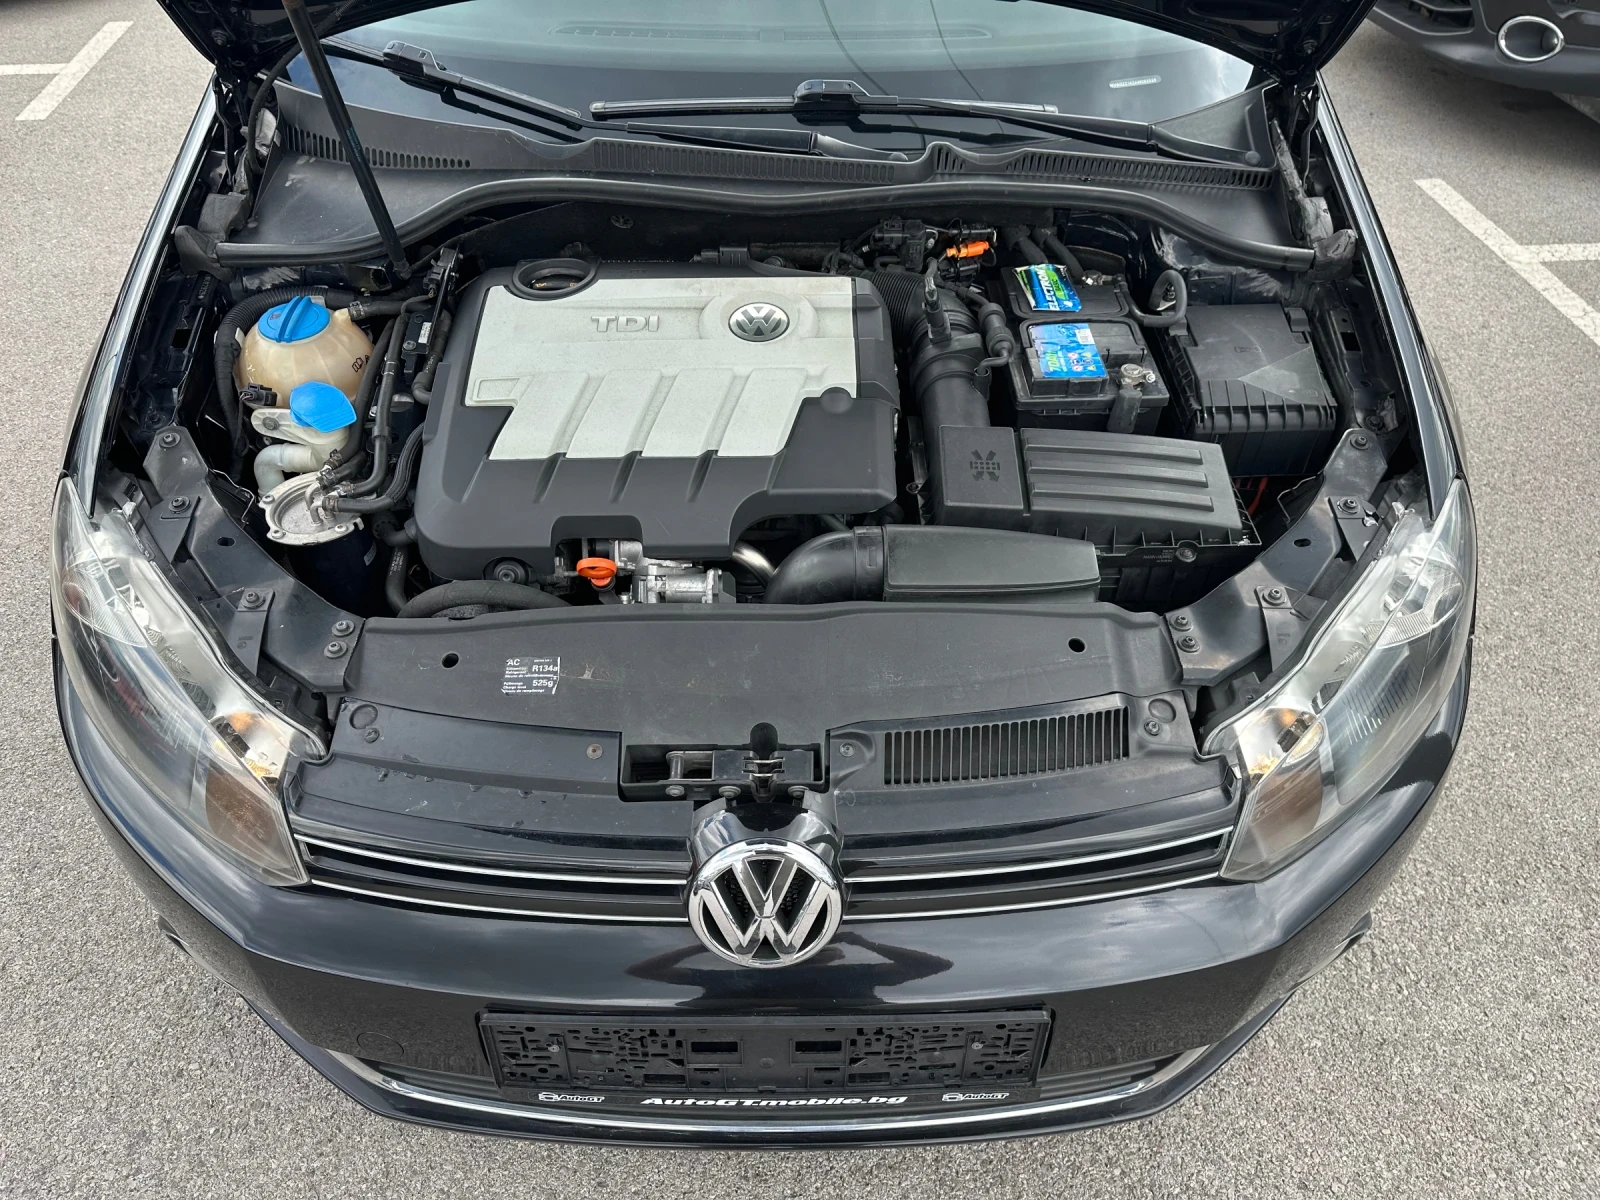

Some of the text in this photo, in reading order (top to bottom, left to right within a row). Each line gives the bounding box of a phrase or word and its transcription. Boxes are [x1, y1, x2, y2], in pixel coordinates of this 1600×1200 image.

[591, 315, 660, 333] TDI
[507, 658, 520, 666] AC
[532, 664, 558, 672] R134a
[532, 679, 554, 688] 525g
[559, 1094, 605, 1103] AutoGT
[962, 1092, 1010, 1100] AutoGT
